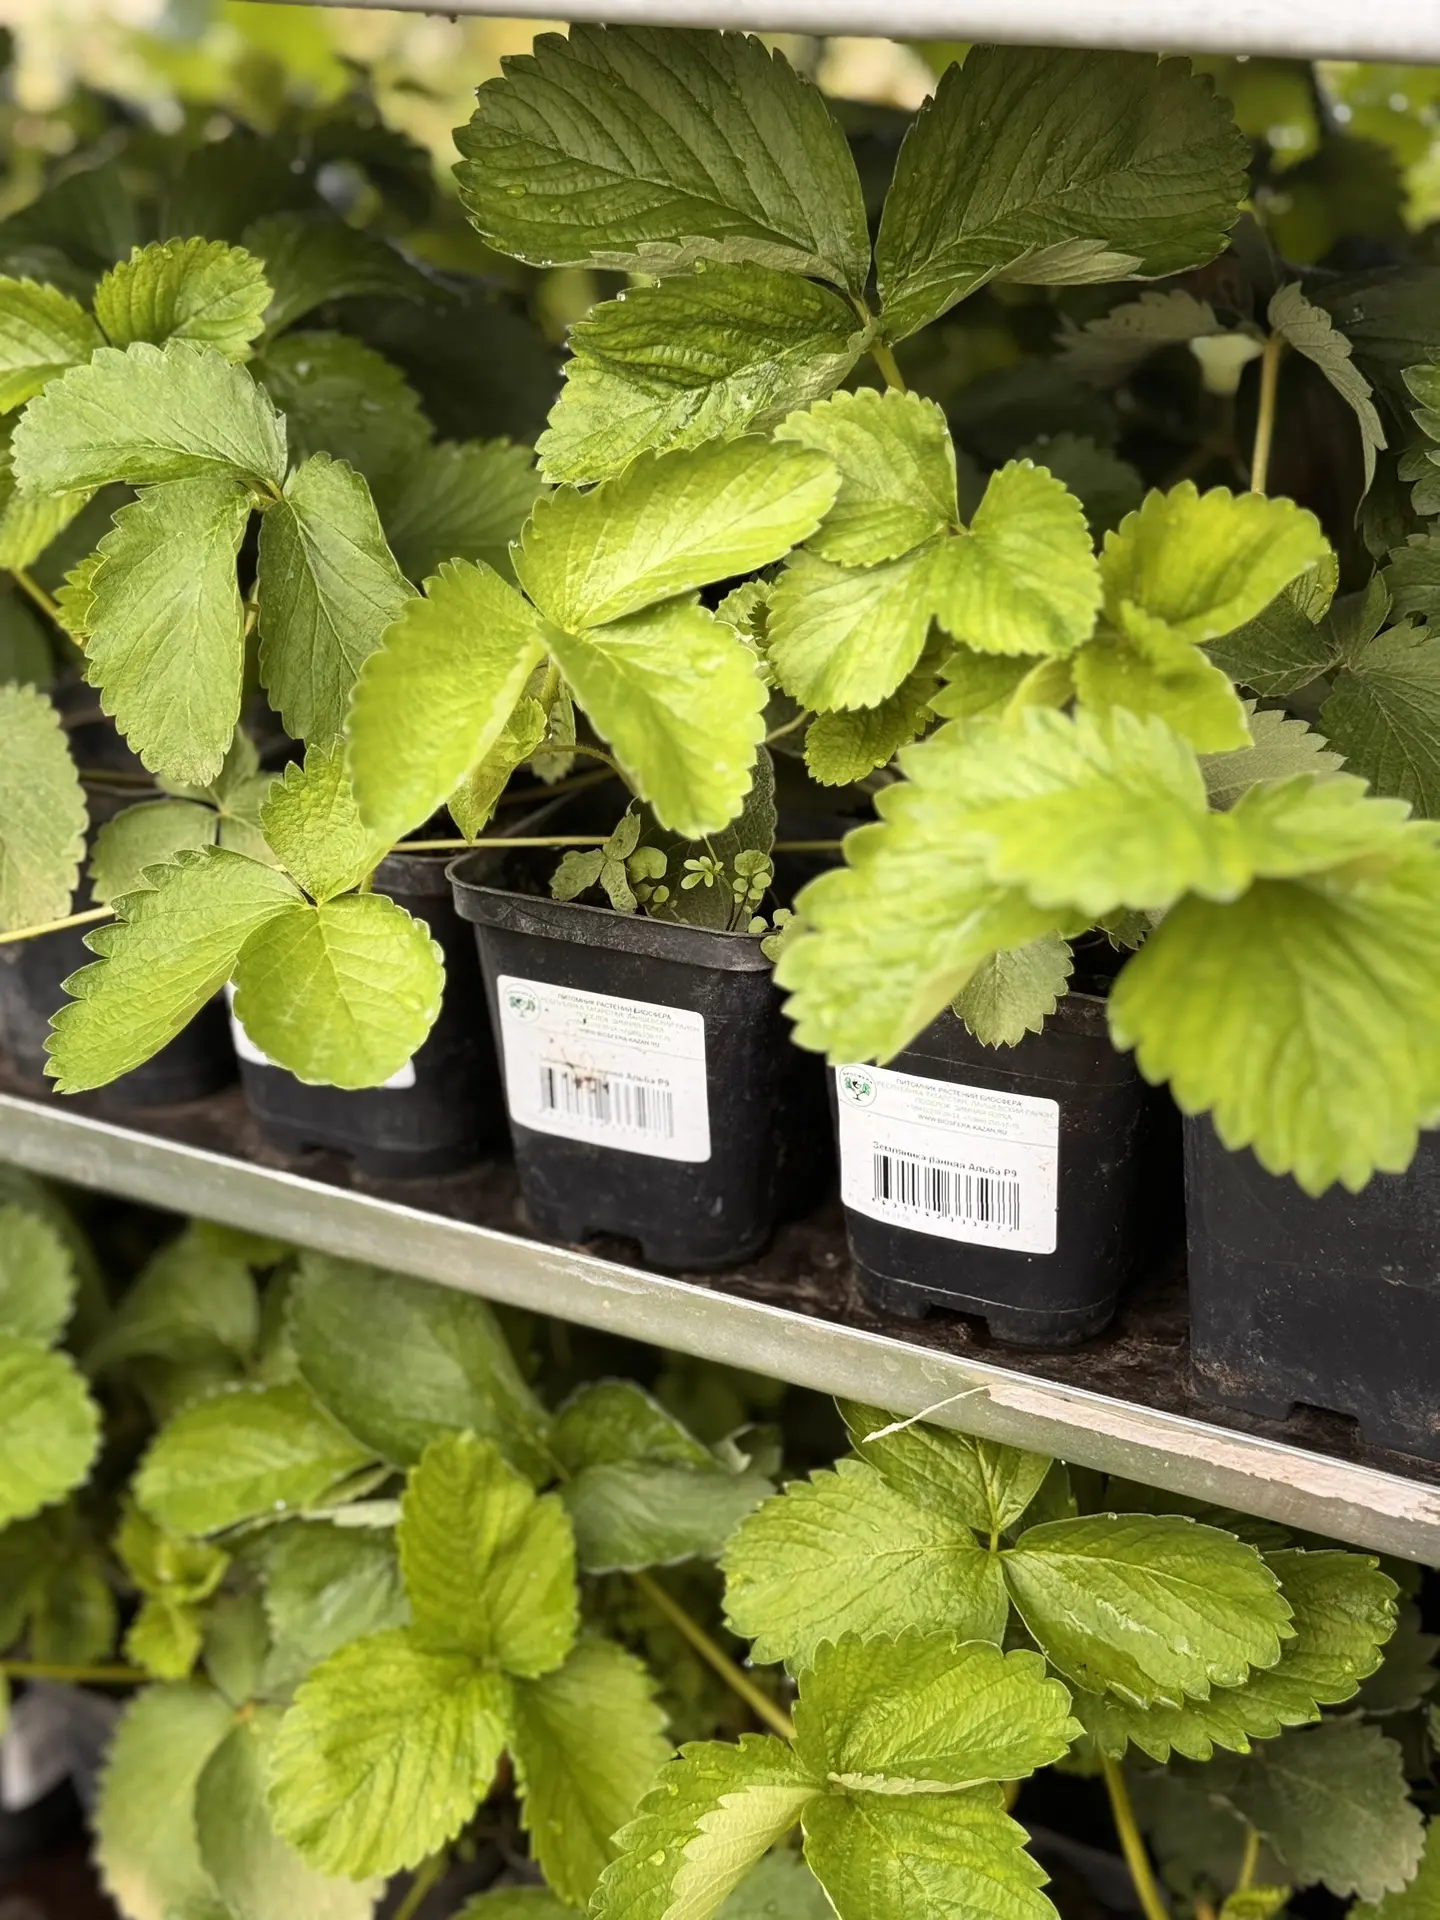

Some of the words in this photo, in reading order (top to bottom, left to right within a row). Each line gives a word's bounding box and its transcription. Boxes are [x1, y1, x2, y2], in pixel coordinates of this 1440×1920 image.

[980, 1094, 1023, 1107] БИОСФЕРА
[872, 1140, 927, 1161] Земляника
[928, 1156, 966, 1169] ранняя
[968, 1163, 1001, 1176] Альба
